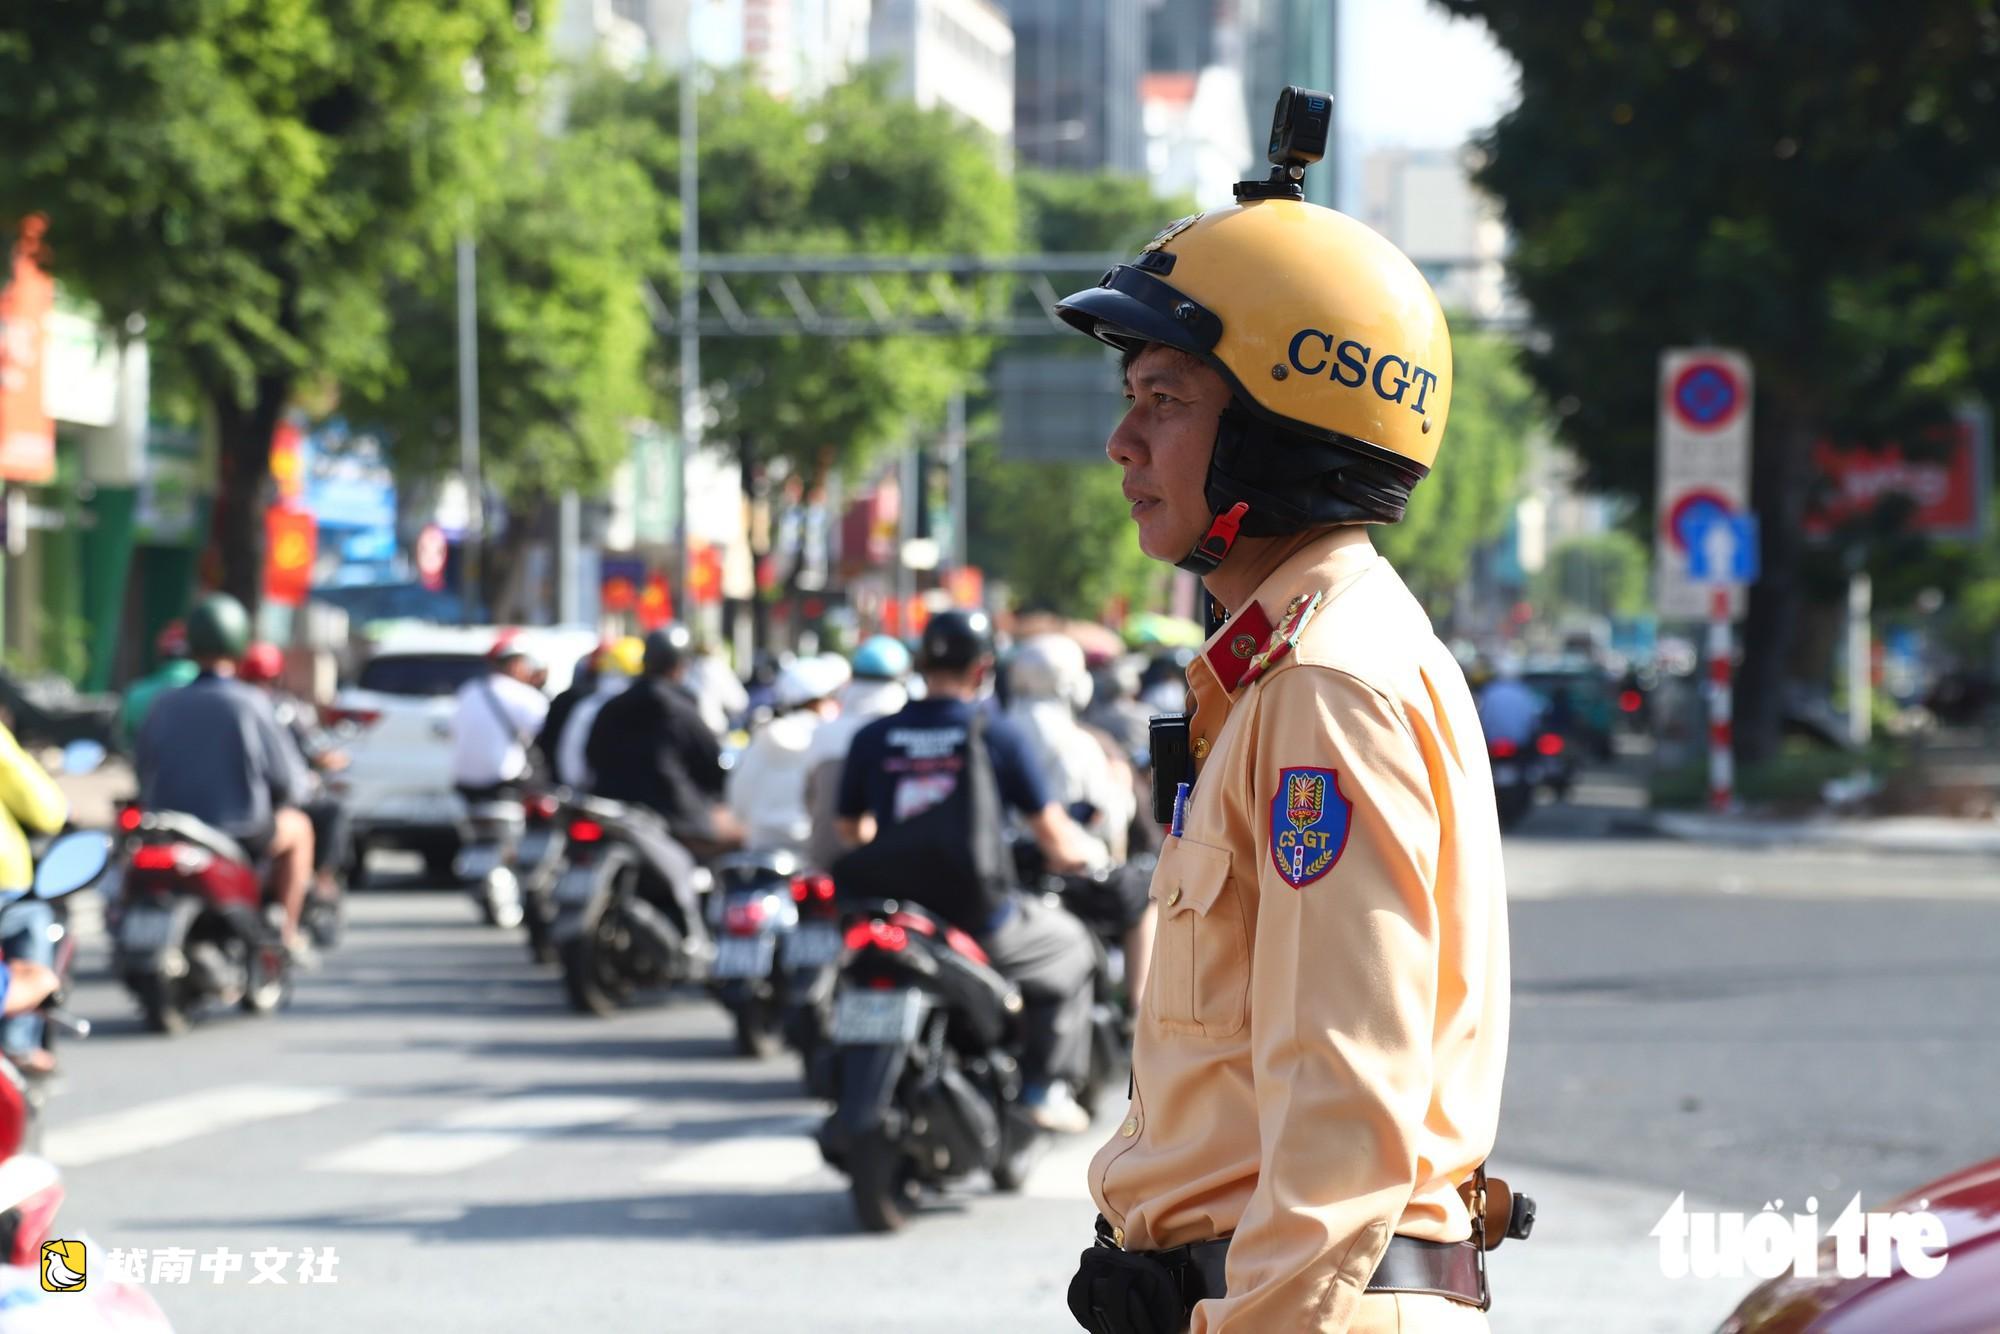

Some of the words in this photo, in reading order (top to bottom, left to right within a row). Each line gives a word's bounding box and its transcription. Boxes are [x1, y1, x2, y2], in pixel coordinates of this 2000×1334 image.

[1288, 328, 1437, 415] CSGT
[1279, 831, 1296, 847] CS
[1303, 830, 1330, 849] GT
